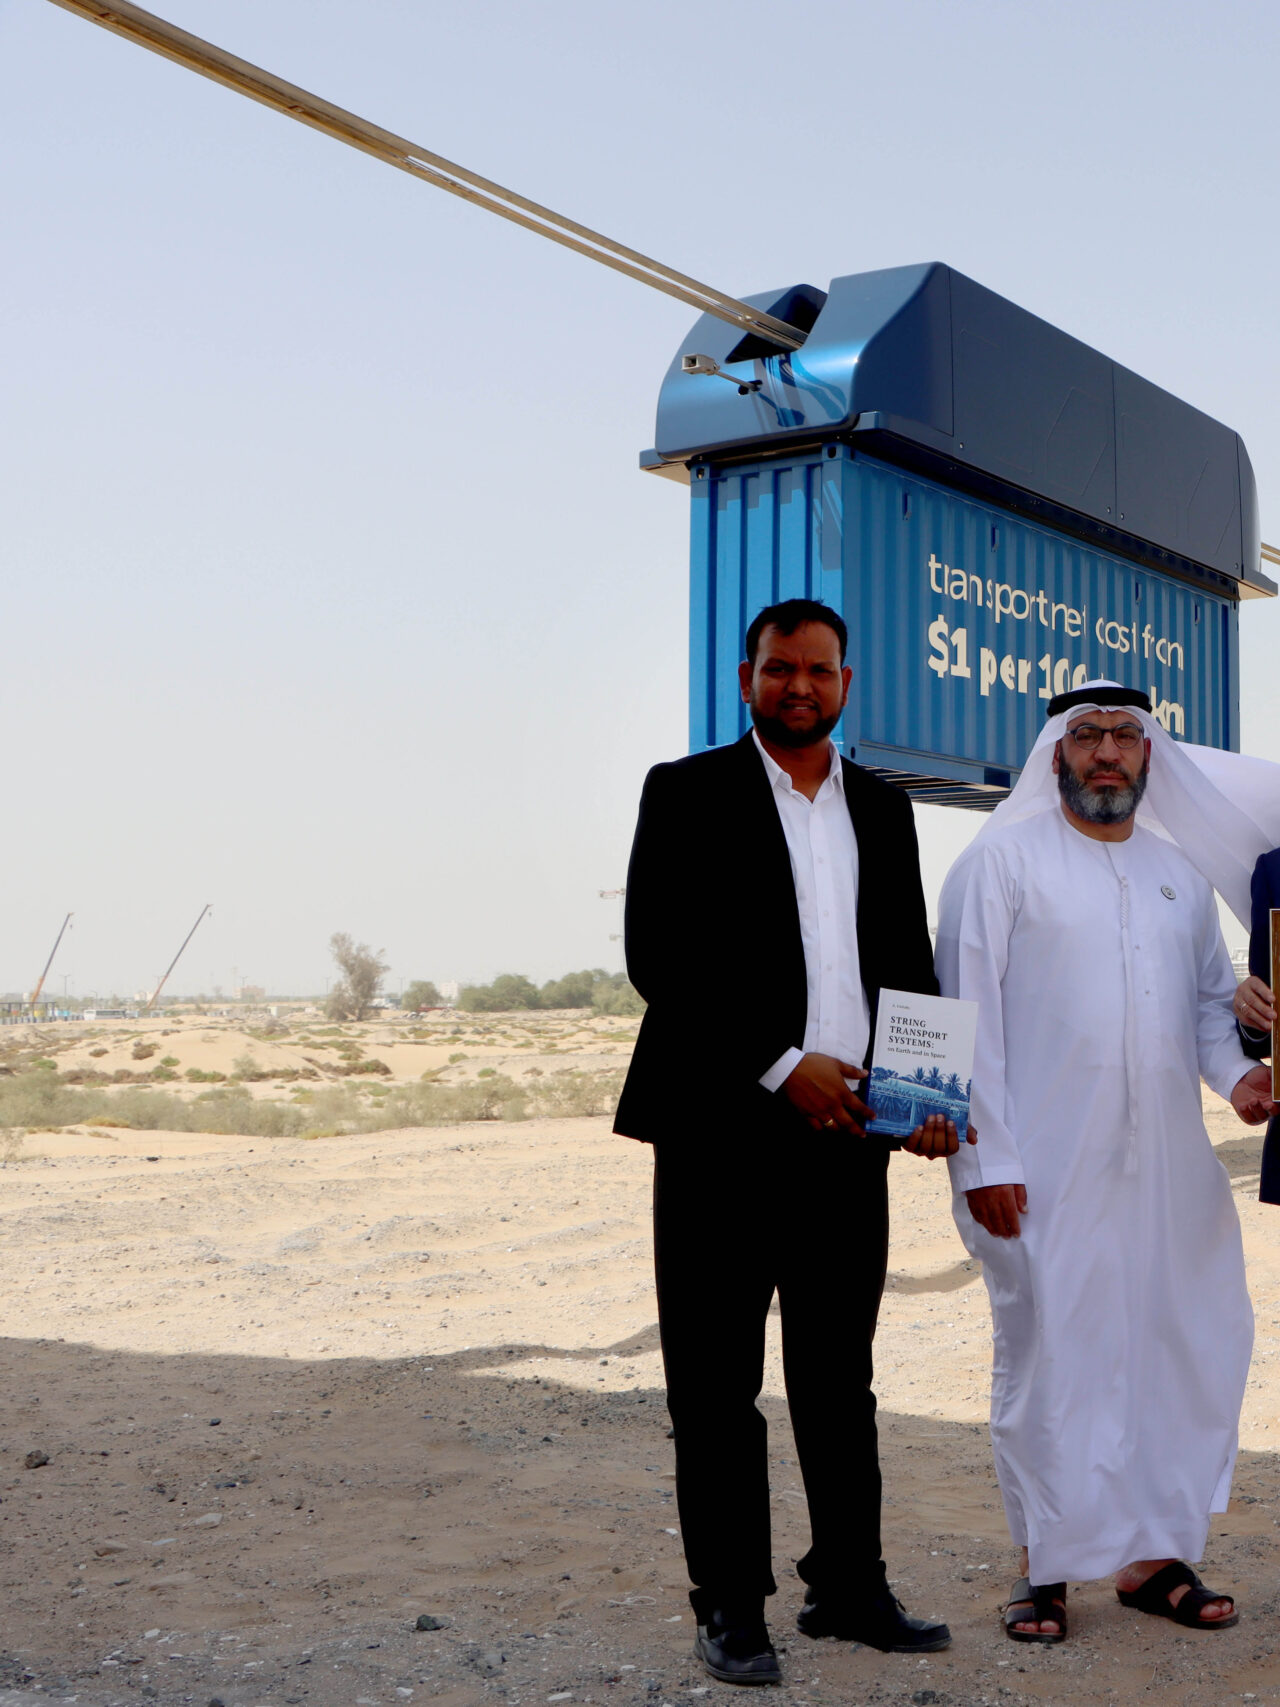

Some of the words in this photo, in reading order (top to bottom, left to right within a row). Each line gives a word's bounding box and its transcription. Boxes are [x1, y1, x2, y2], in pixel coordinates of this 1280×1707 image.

[1095, 616, 1137, 654] cost
[927, 613, 972, 679] $1
[980, 646, 1032, 697] per
[890, 1016, 926, 1028] STRING
[889, 1025, 948, 1041] TRANSPORT
[888, 1035, 935, 1049] SYSTEMS:
[896, 1047, 910, 1055] Earth
[931, 1052, 946, 1060] Space
